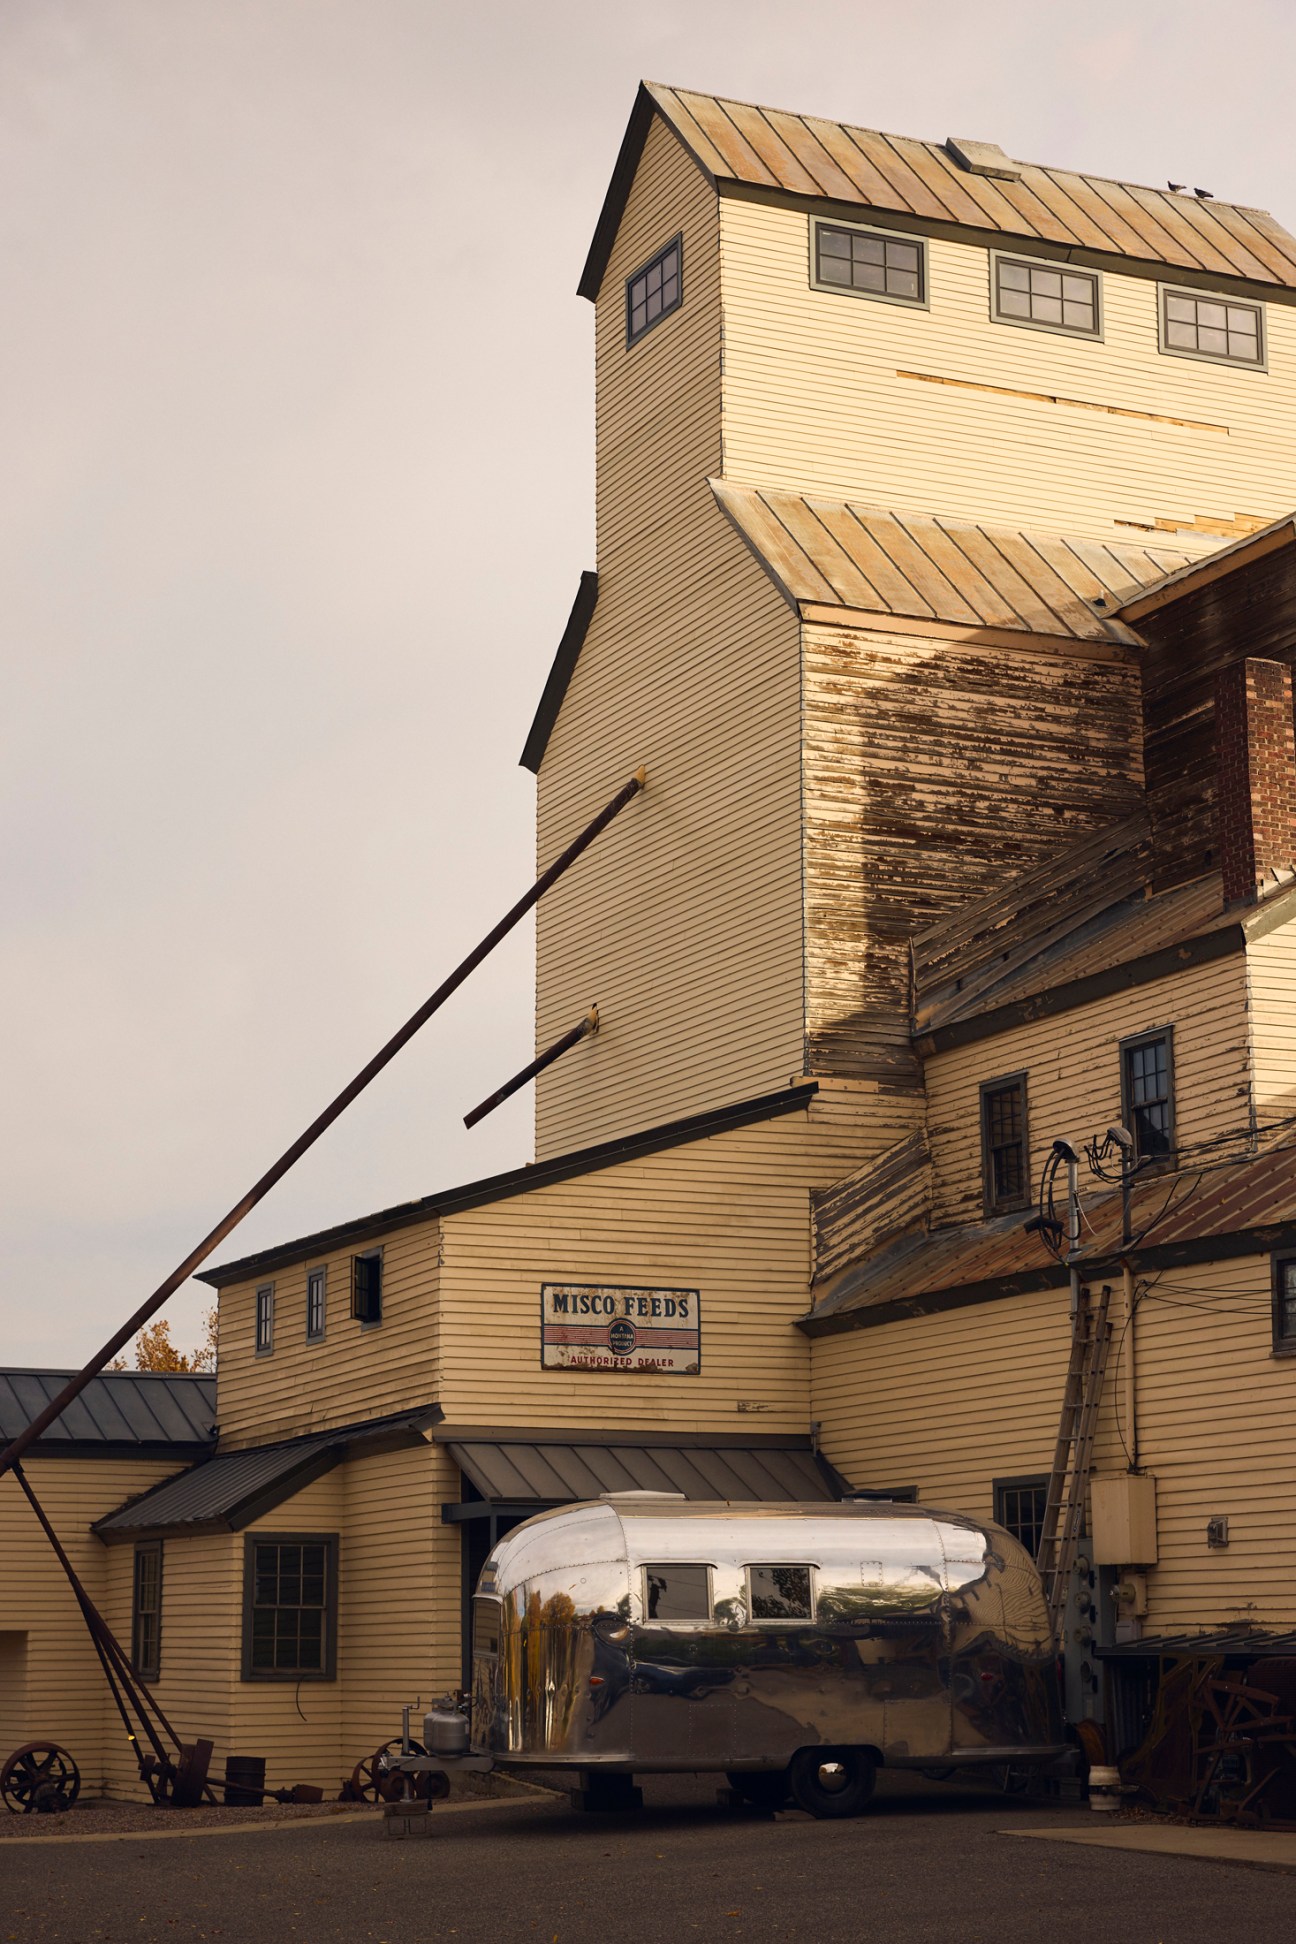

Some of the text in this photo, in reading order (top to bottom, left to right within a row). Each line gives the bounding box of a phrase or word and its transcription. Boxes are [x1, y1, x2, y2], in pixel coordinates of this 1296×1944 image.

[552, 1293, 689, 1318] MISCO FEEDS
[570, 1355, 674, 1367] AUTHORIZED DEALER
